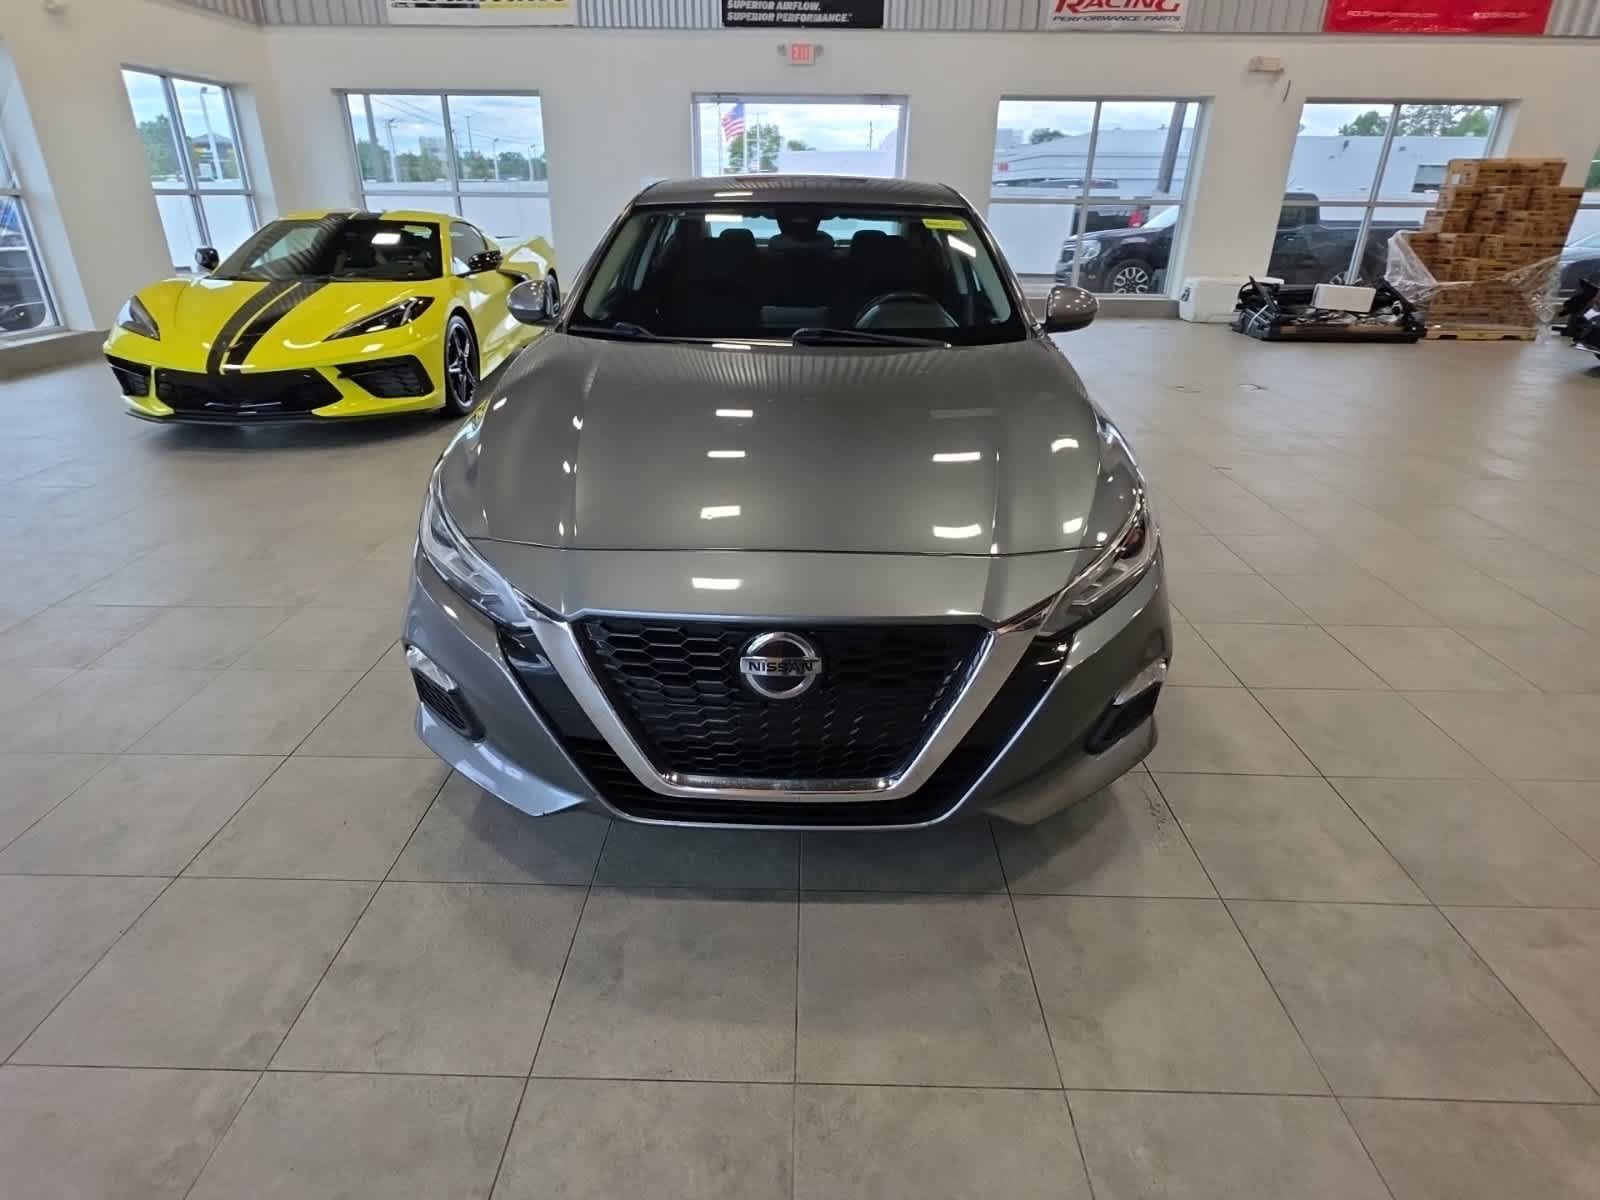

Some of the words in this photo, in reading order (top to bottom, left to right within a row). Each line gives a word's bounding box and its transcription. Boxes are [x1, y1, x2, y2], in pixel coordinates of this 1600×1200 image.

[727, 0, 775, 9] SUPERIOR
[776, 1, 821, 10] AIRFLOW.
[1055, 0, 1180, 13] RACING
[727, 12, 775, 21] SUPERIOR
[749, 661, 813, 672] NISSAN
